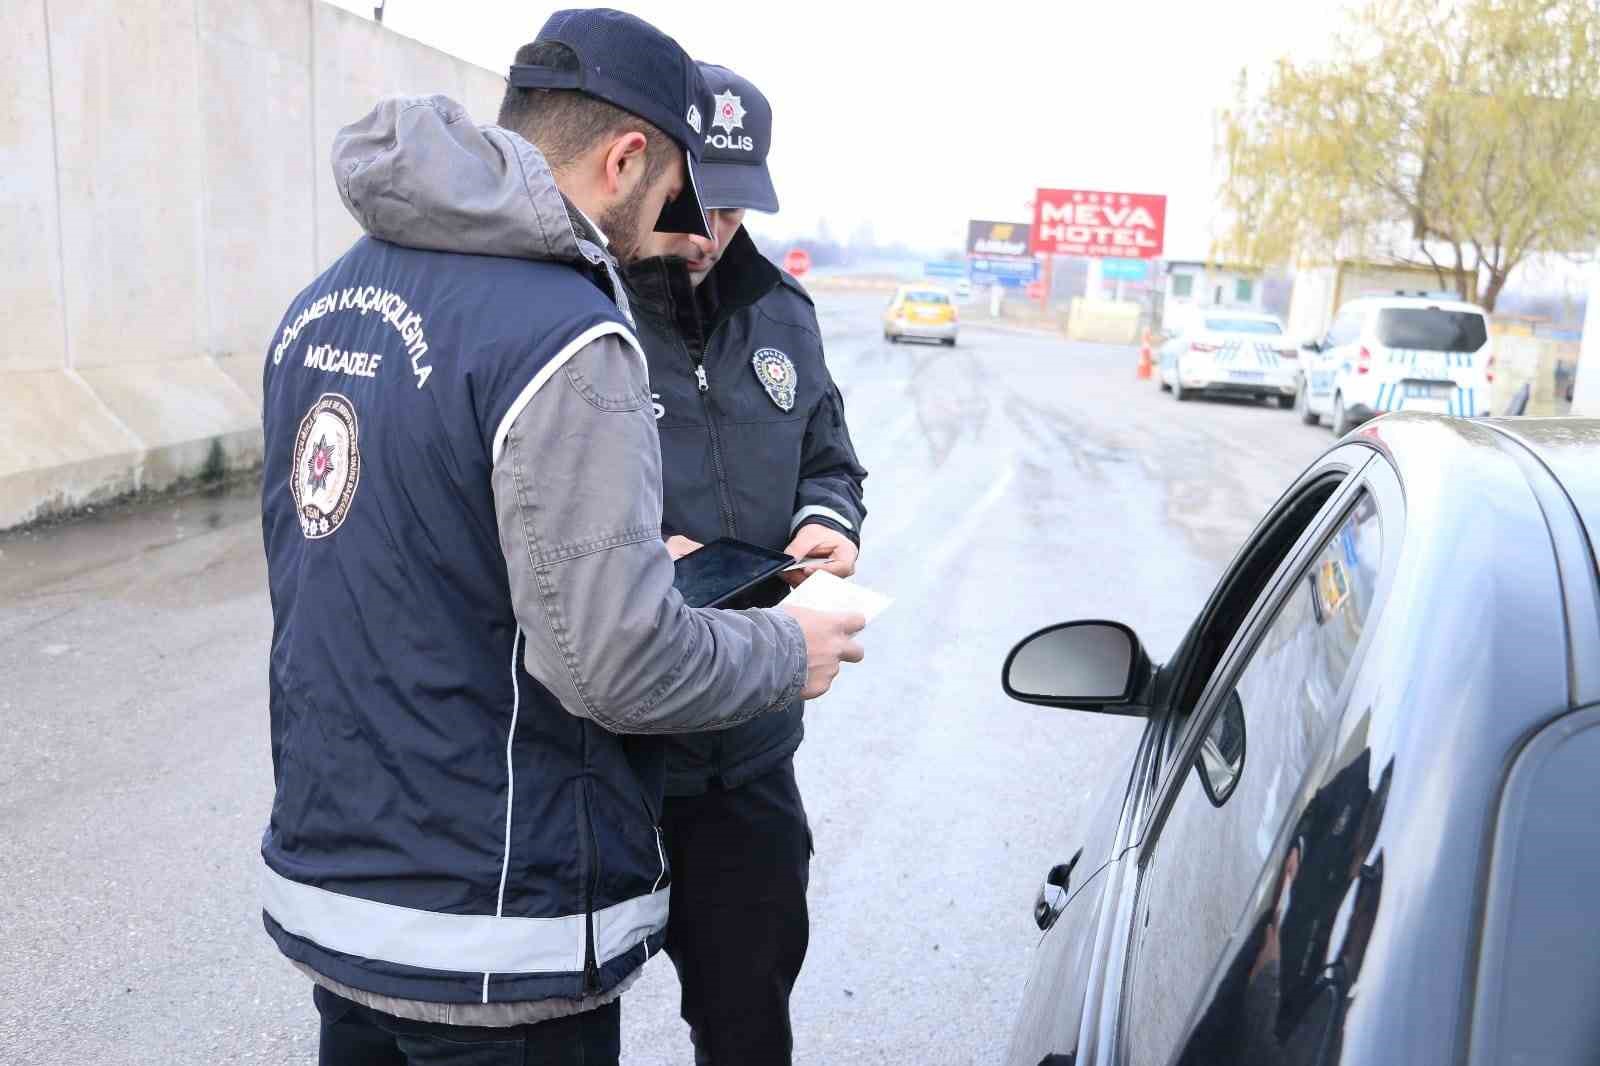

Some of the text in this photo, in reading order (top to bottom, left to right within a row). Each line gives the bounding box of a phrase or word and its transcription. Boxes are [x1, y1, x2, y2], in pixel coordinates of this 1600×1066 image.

[1041, 202, 1156, 229] MEVA
[1039, 225, 1156, 247] HOTEL
[303, 344, 383, 378] MÜCADELE
